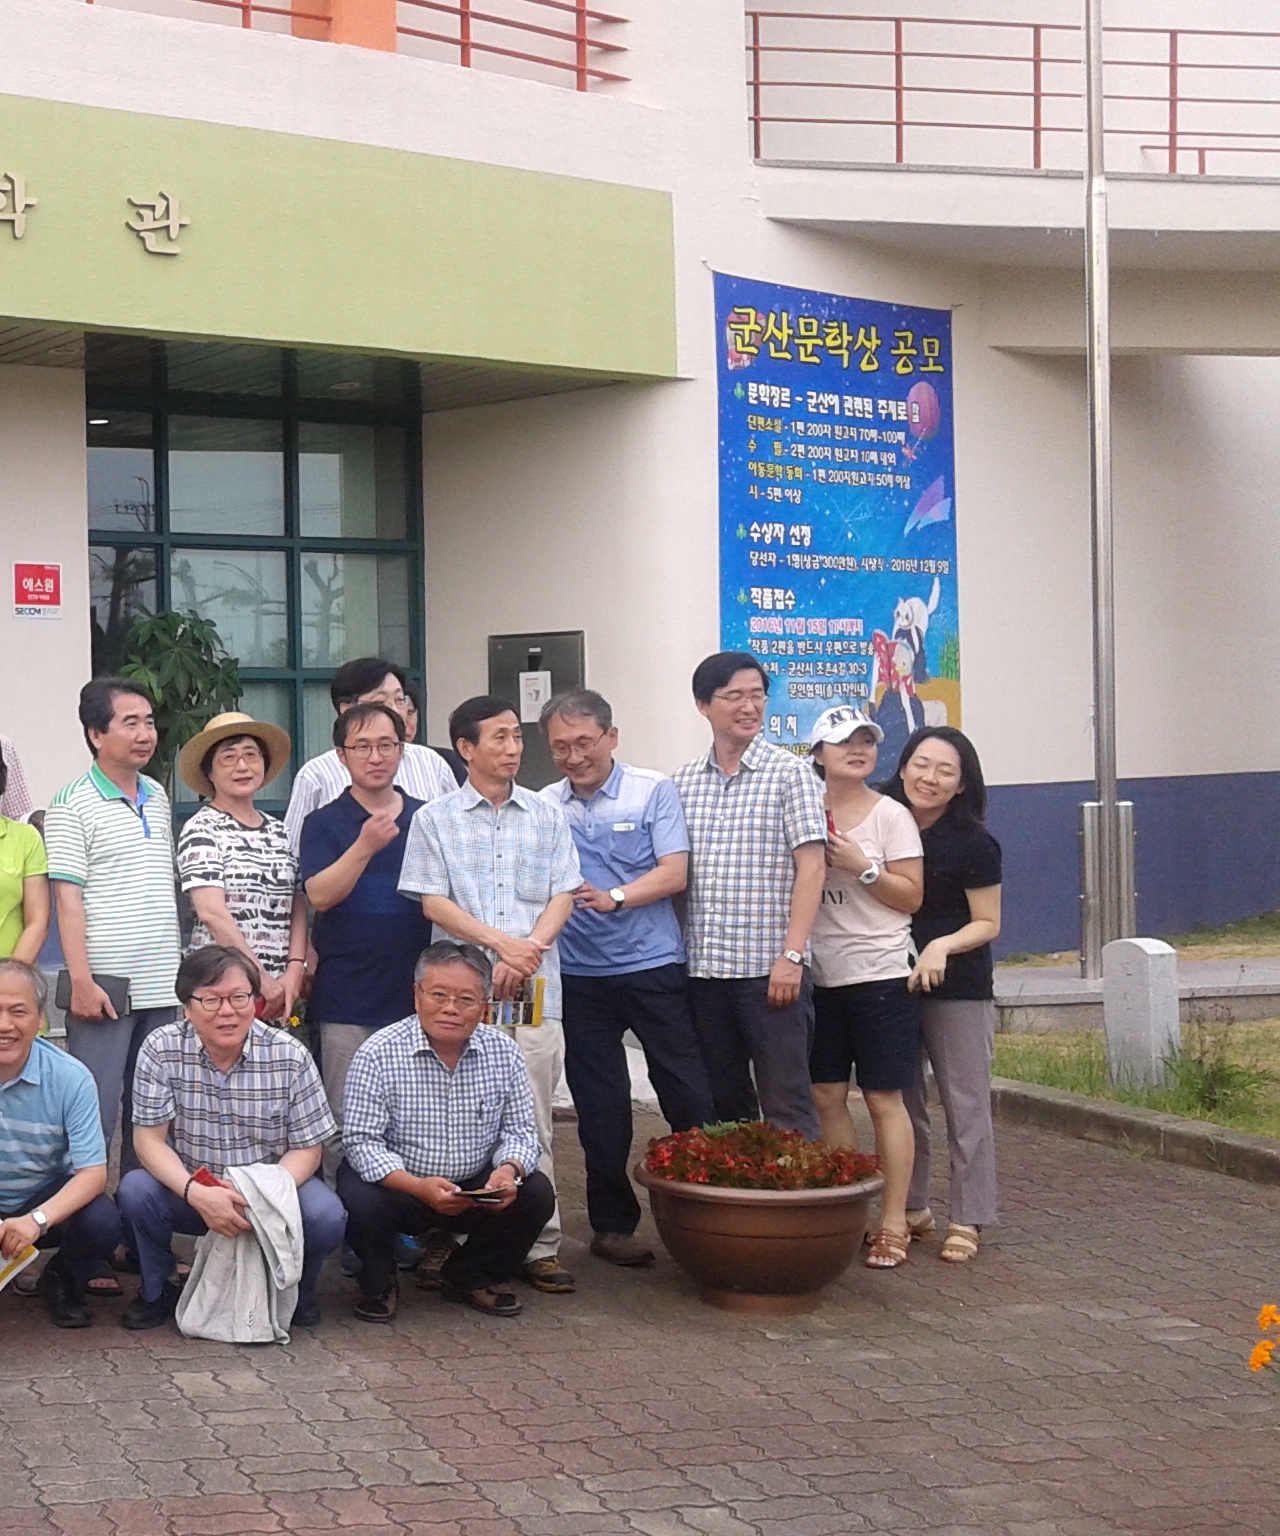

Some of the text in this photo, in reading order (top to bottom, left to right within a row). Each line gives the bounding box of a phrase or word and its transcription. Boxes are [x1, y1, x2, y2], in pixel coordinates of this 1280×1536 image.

[729, 305, 945, 375] 군산문학상 공모
[748, 382, 791, 408] 문학장르
[806, 390, 840, 415] 군산에
[843, 395, 873, 419] 관련된
[790, 421, 805, 437] 1편
[807, 422, 831, 439] 200자
[834, 425, 857, 442] 원고지
[790, 443, 805, 459] 2편
[807, 445, 832, 461] 200자
[834, 448, 858, 463] 원고지
[812, 468, 826, 483] 1편
[766, 486, 782, 502] 5편
[784, 488, 802, 504] 이상
[750, 521, 811, 547] 수상자 선정
[749, 550, 776, 568] 당선자
[891, 557, 918, 574] 2016년
[22, 577, 54, 593] 에스원
[750, 587, 796, 610] 작품접수
[751, 639, 768, 655] 작품
[771, 640, 795, 655] 2편을
[797, 640, 823, 656] 반드시
[825, 640, 858, 656] 우편으로
[788, 661, 813, 677] 군산시
[848, 662, 868, 676] 30-3
